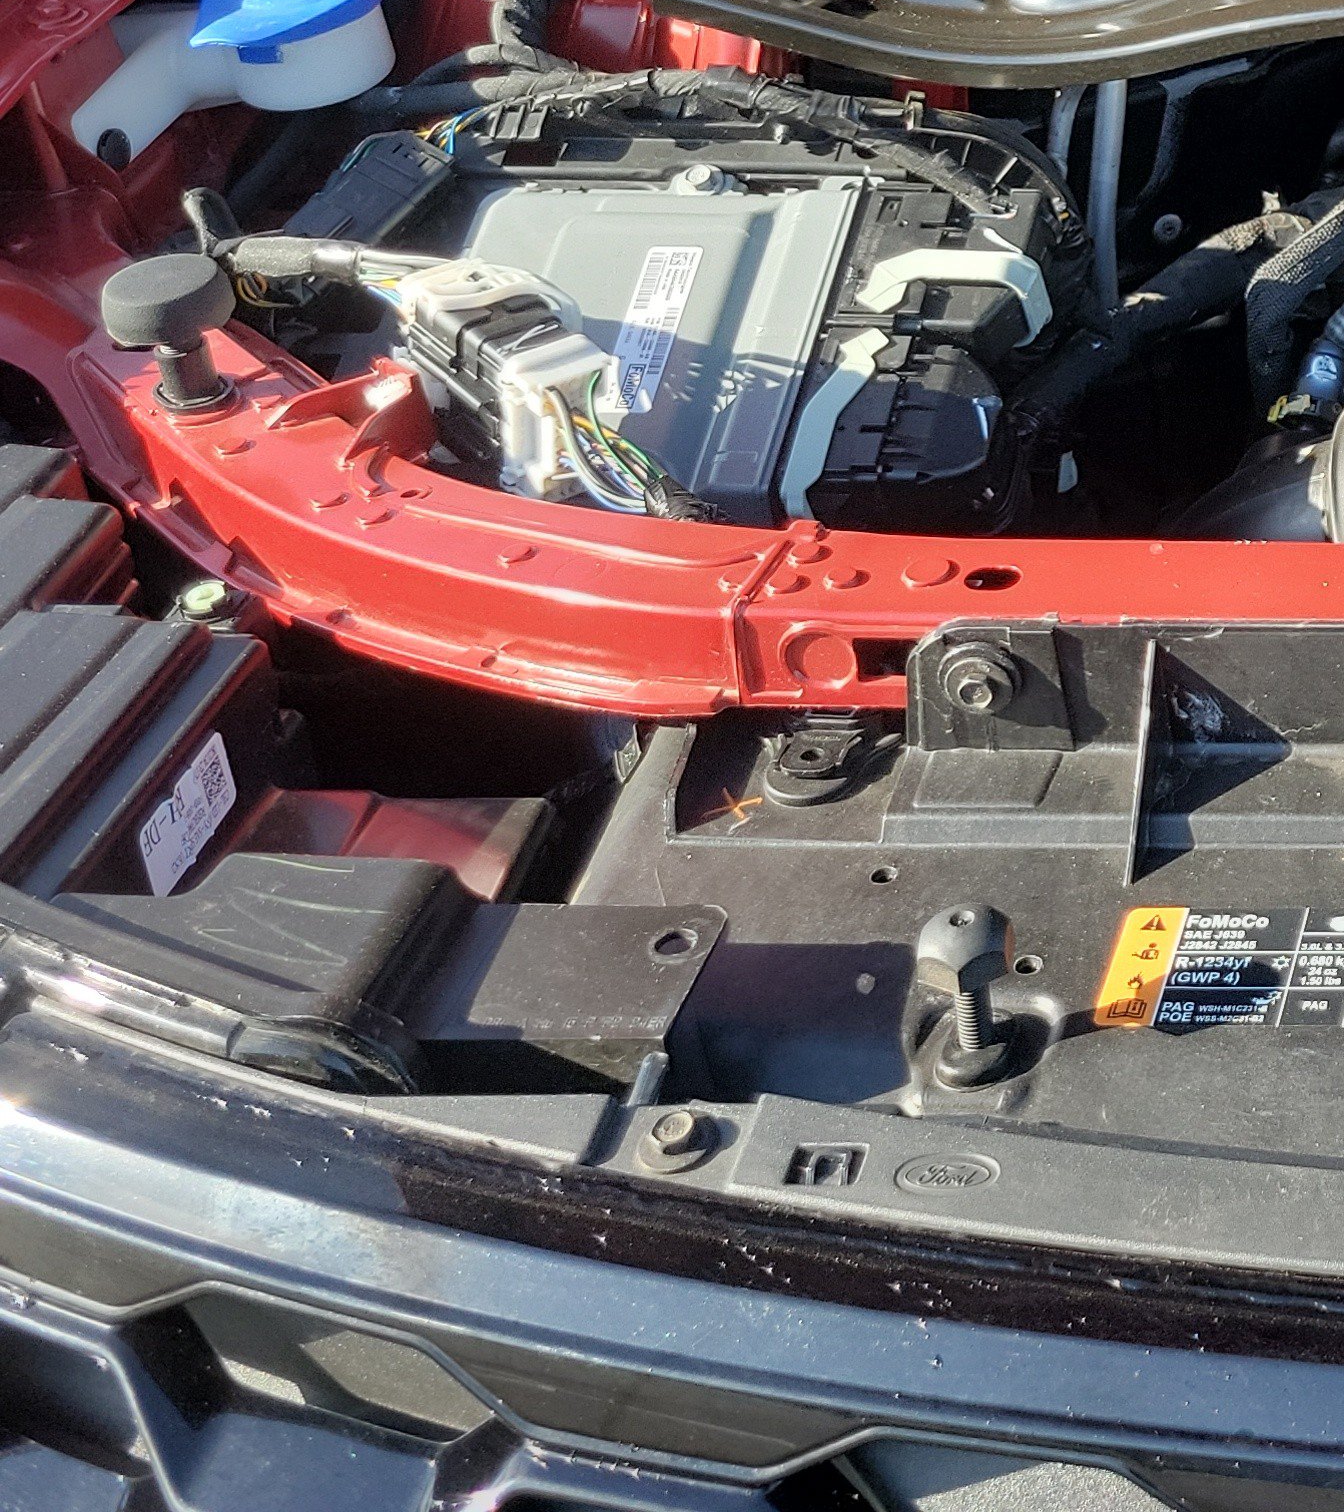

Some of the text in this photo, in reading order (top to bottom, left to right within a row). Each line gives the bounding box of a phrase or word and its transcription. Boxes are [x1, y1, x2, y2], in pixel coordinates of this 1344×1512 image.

[621, 366, 644, 406] FoMoCo
[1186, 914, 1270, 929] FoMoCo
[1183, 930, 1213, 940] SAE
[1175, 956, 1252, 971] R-1234yf
[1323, 968, 1338, 976] oz
[1171, 972, 1241, 985] (GWP 4)
[1323, 976, 1341, 985] lbs
[1161, 1001, 1196, 1011] PAG
[1302, 1000, 1329, 1011] PAG
[1159, 1012, 1193, 1022] POE
[917, 1163, 978, 1187] Ford
